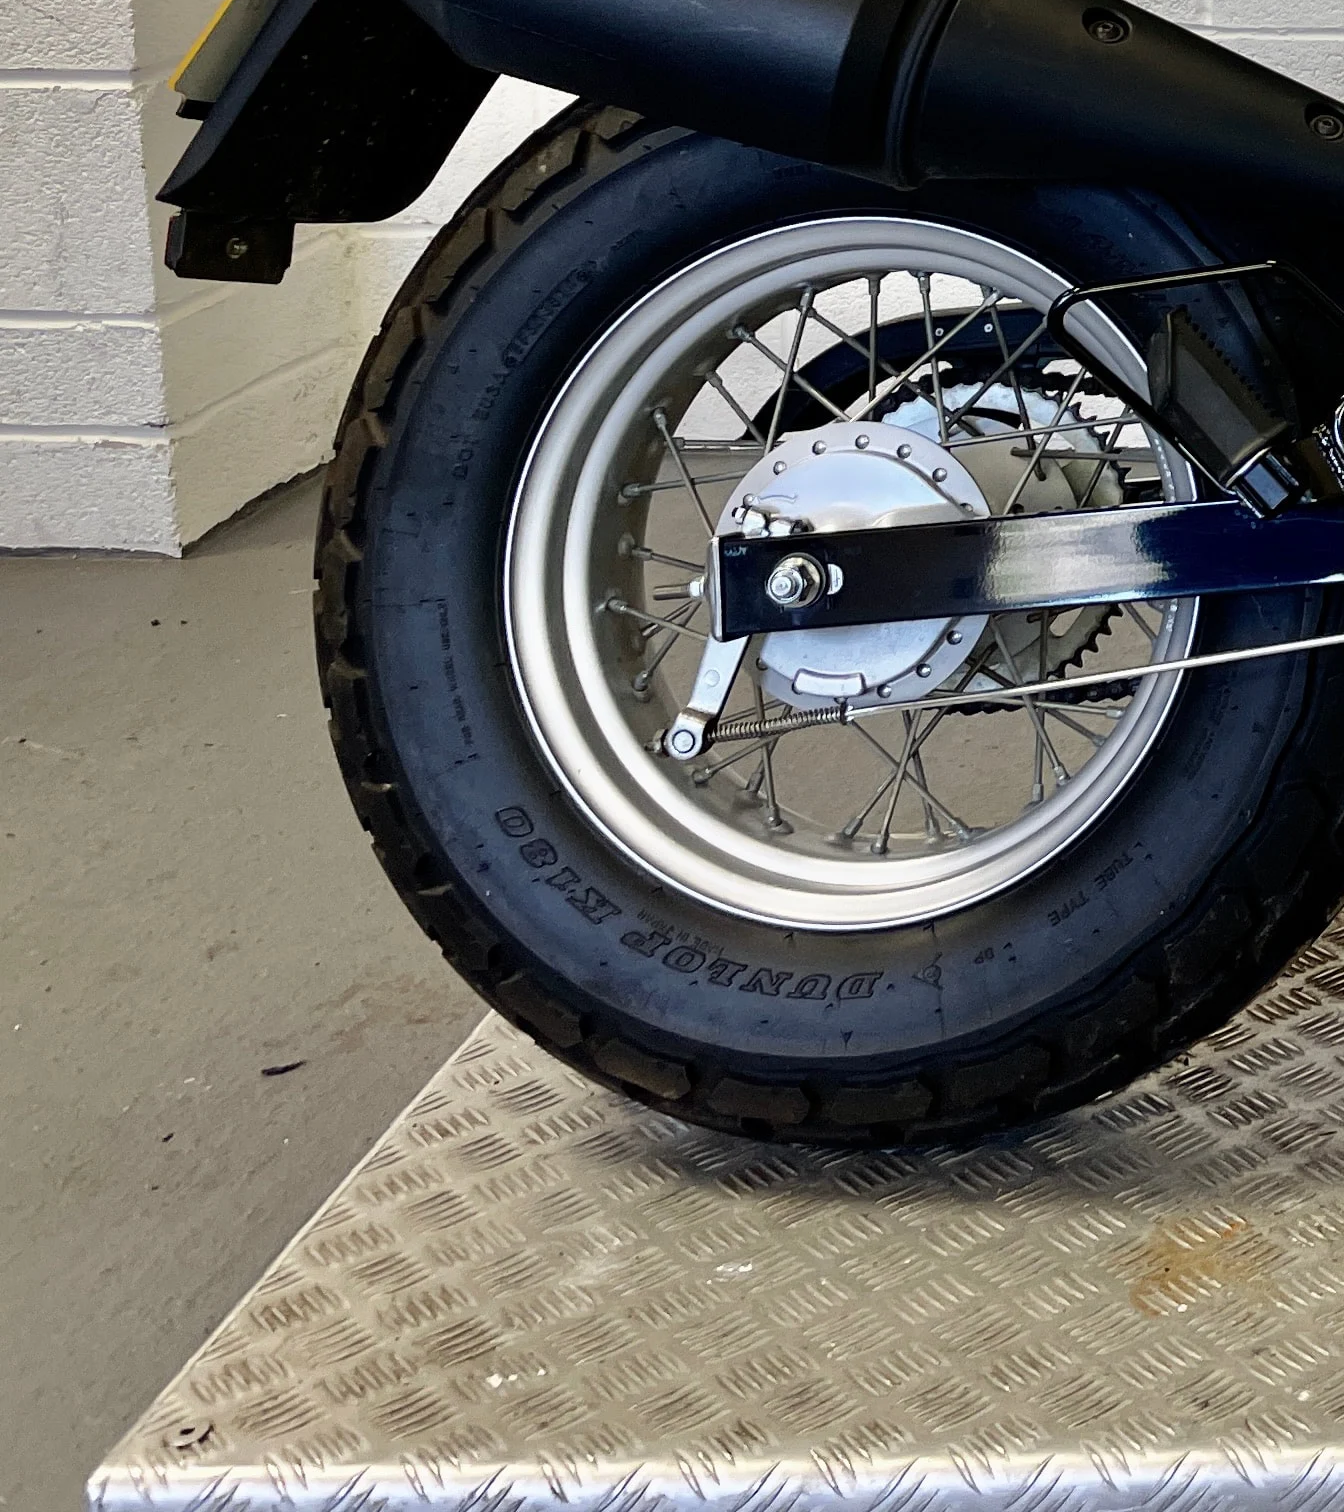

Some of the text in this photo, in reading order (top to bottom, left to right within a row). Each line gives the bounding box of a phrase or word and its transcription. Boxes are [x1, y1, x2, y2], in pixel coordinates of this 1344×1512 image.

[493, 805, 885, 1002] DUNLOP K180
[1046, 849, 1135, 928] TUBE TYPE
